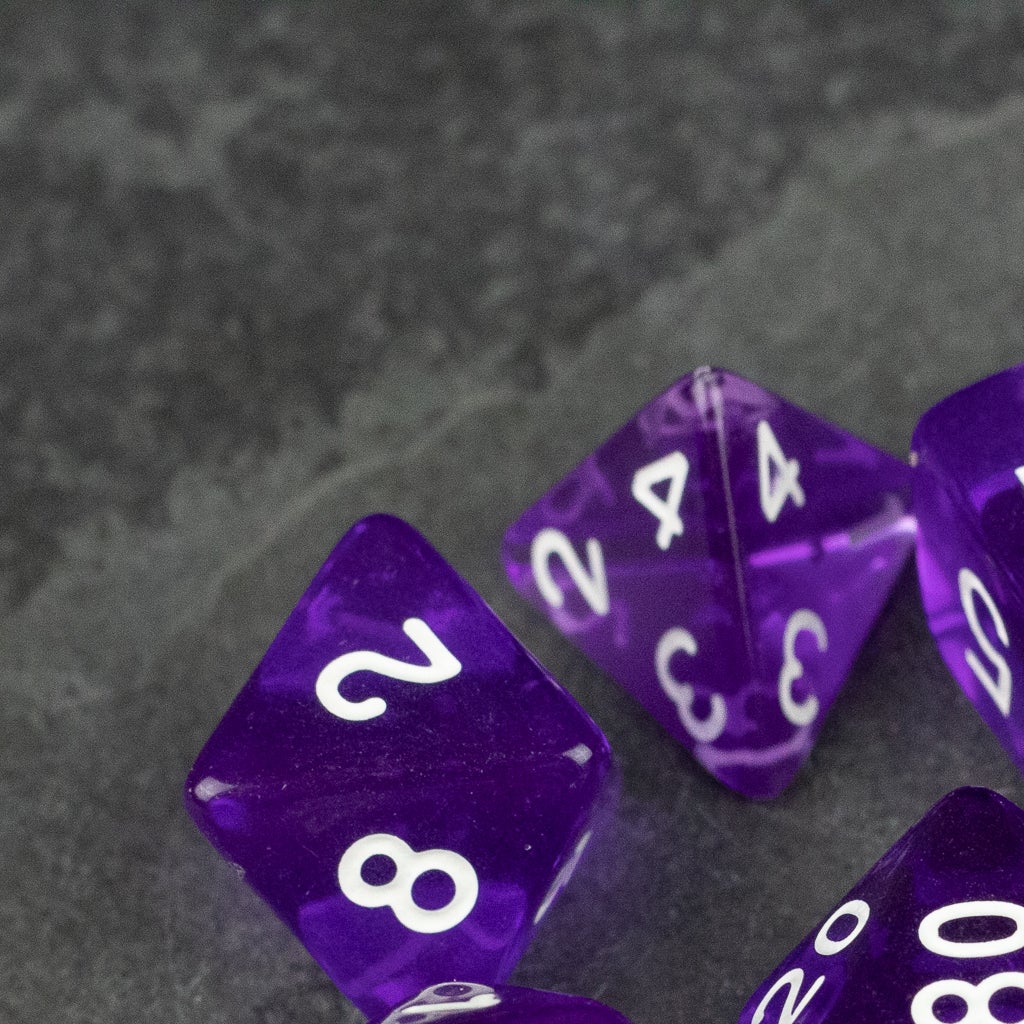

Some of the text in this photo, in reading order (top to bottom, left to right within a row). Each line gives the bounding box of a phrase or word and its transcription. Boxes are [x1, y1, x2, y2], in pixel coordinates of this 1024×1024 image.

[632, 451, 690, 550] 4
[757, 420, 805, 522] 4
[530, 527, 611, 616] 2
[314, 616, 463, 722] 2
[655, 627, 728, 743] 3
[777, 608, 829, 728] 3
[957, 567, 1012, 717] 5
[336, 832, 480, 935] 8
